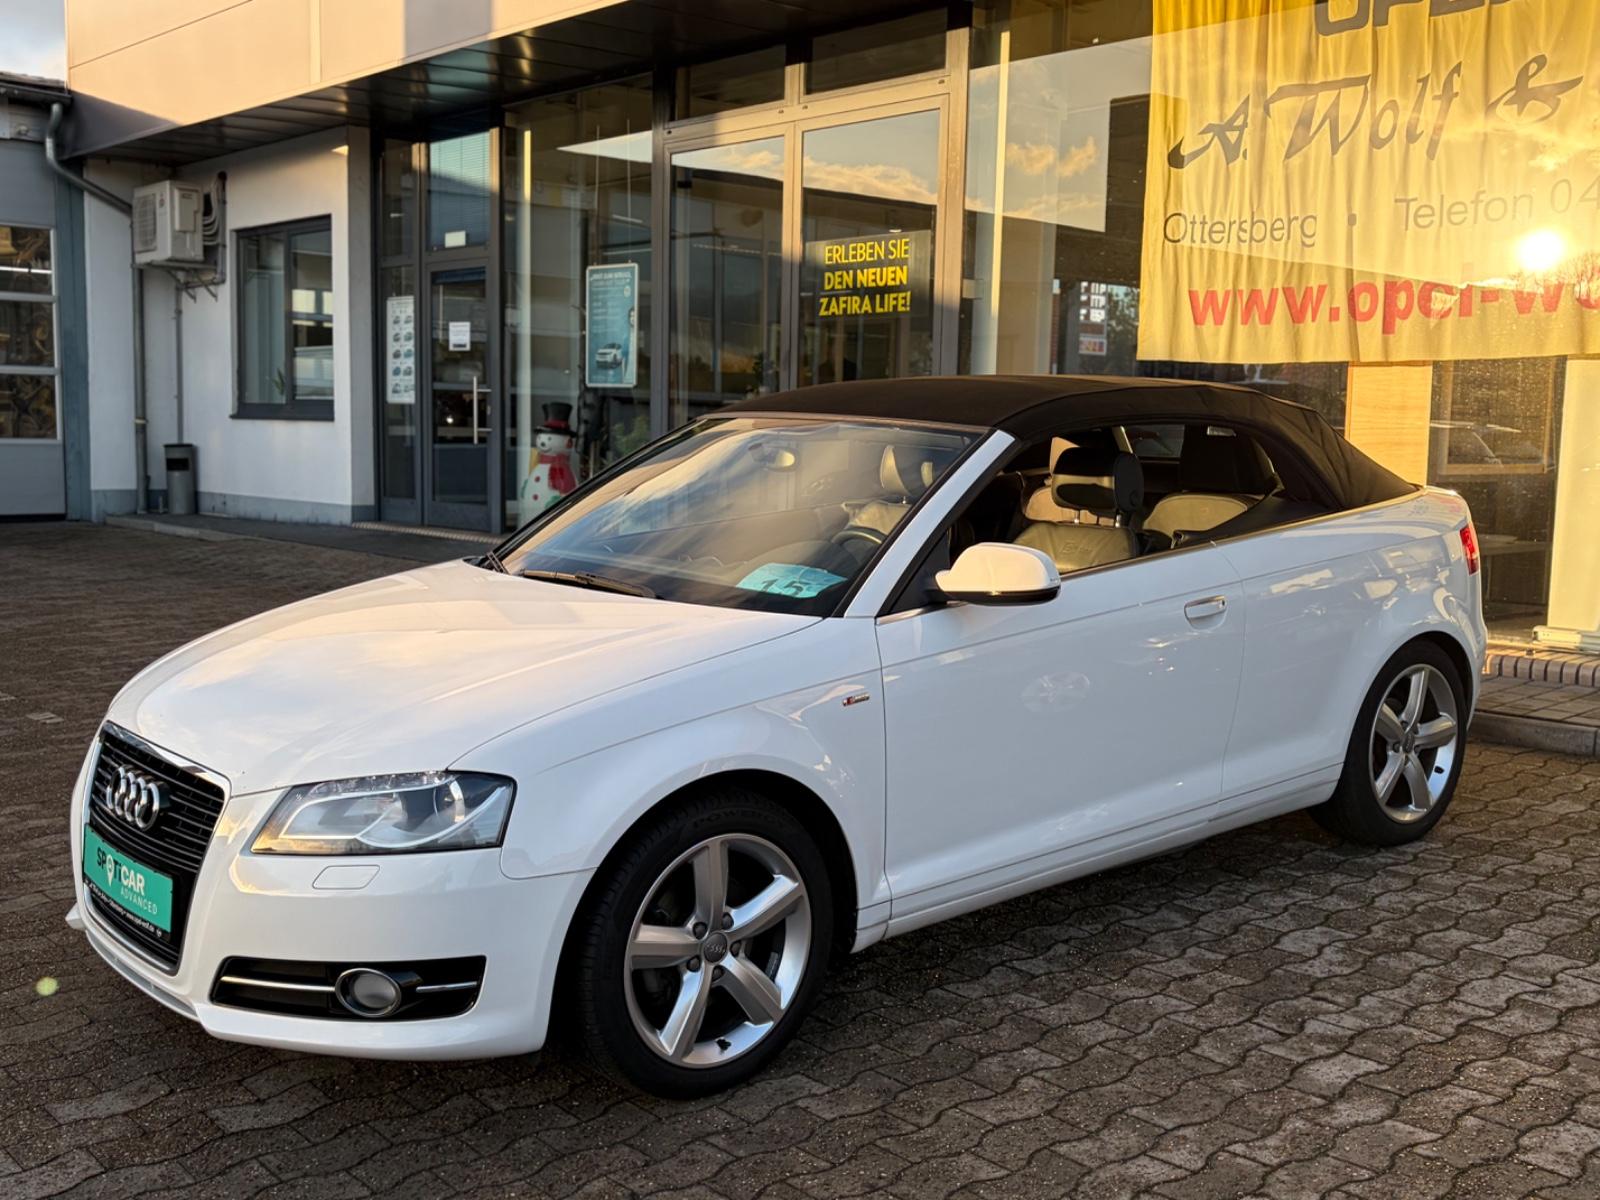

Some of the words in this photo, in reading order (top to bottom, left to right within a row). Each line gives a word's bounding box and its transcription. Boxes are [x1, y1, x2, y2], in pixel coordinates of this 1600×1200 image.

[1263, 61, 1463, 161] Wolf
[1163, 211, 1317, 248] Ottersberg
[1395, 189, 1534, 231] Telefon
[824, 241, 885, 264] ERLEBEN
[888, 238, 910, 259] SIE
[824, 269, 853, 290] DEN
[856, 265, 908, 288] NEUEN
[818, 294, 873, 317] ZAFIRA
[875, 291, 912, 313] LIFE!
[120, 887, 158, 914] ADVANCED
